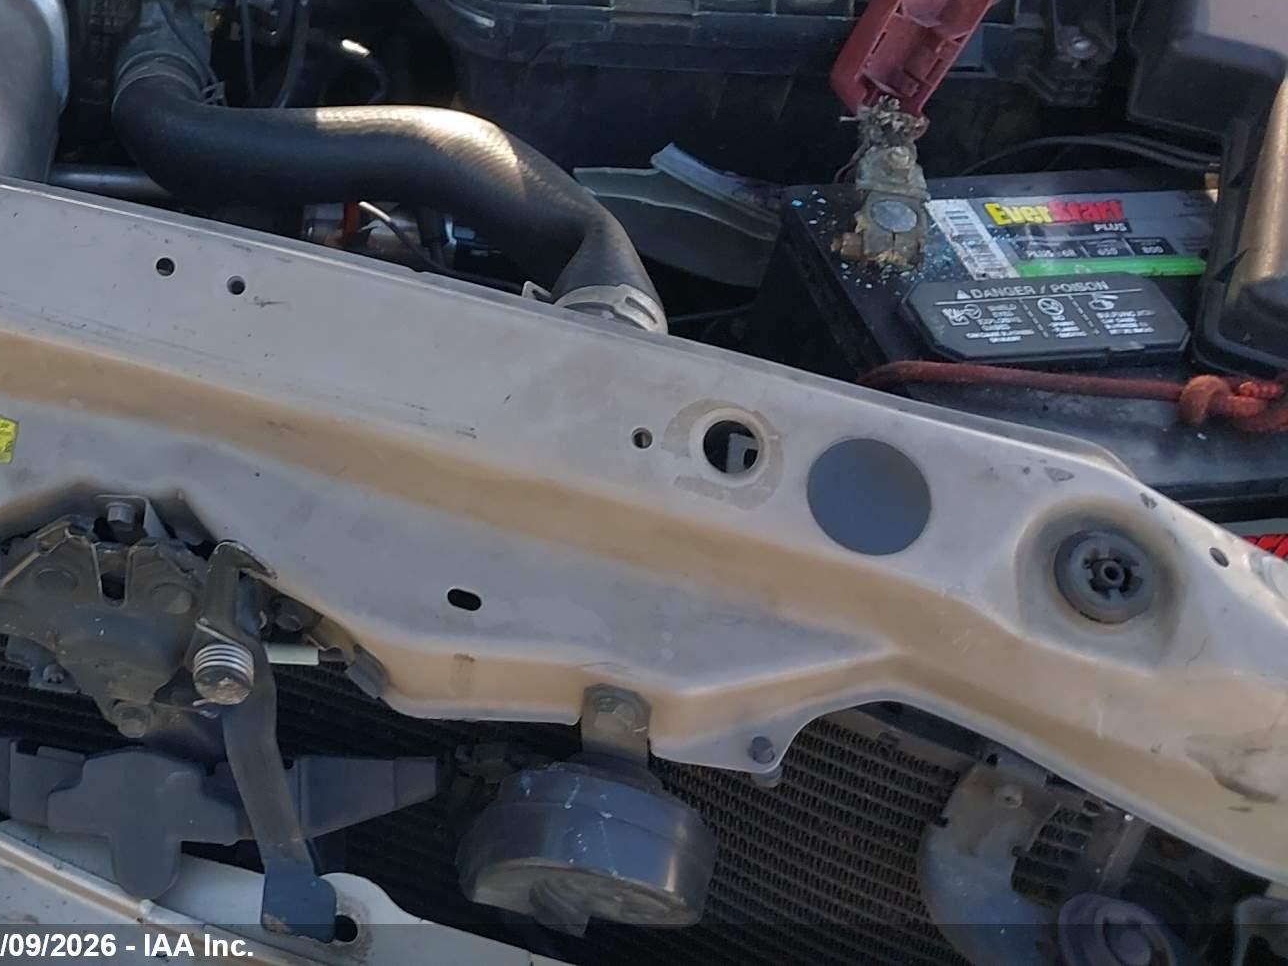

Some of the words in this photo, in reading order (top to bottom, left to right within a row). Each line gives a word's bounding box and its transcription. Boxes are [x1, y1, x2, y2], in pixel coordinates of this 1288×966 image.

[984, 199, 1124, 226] EverStart
[1093, 223, 1128, 233] PLUS
[969, 285, 1036, 299] DANGER
[1051, 280, 1110, 294] POISON
